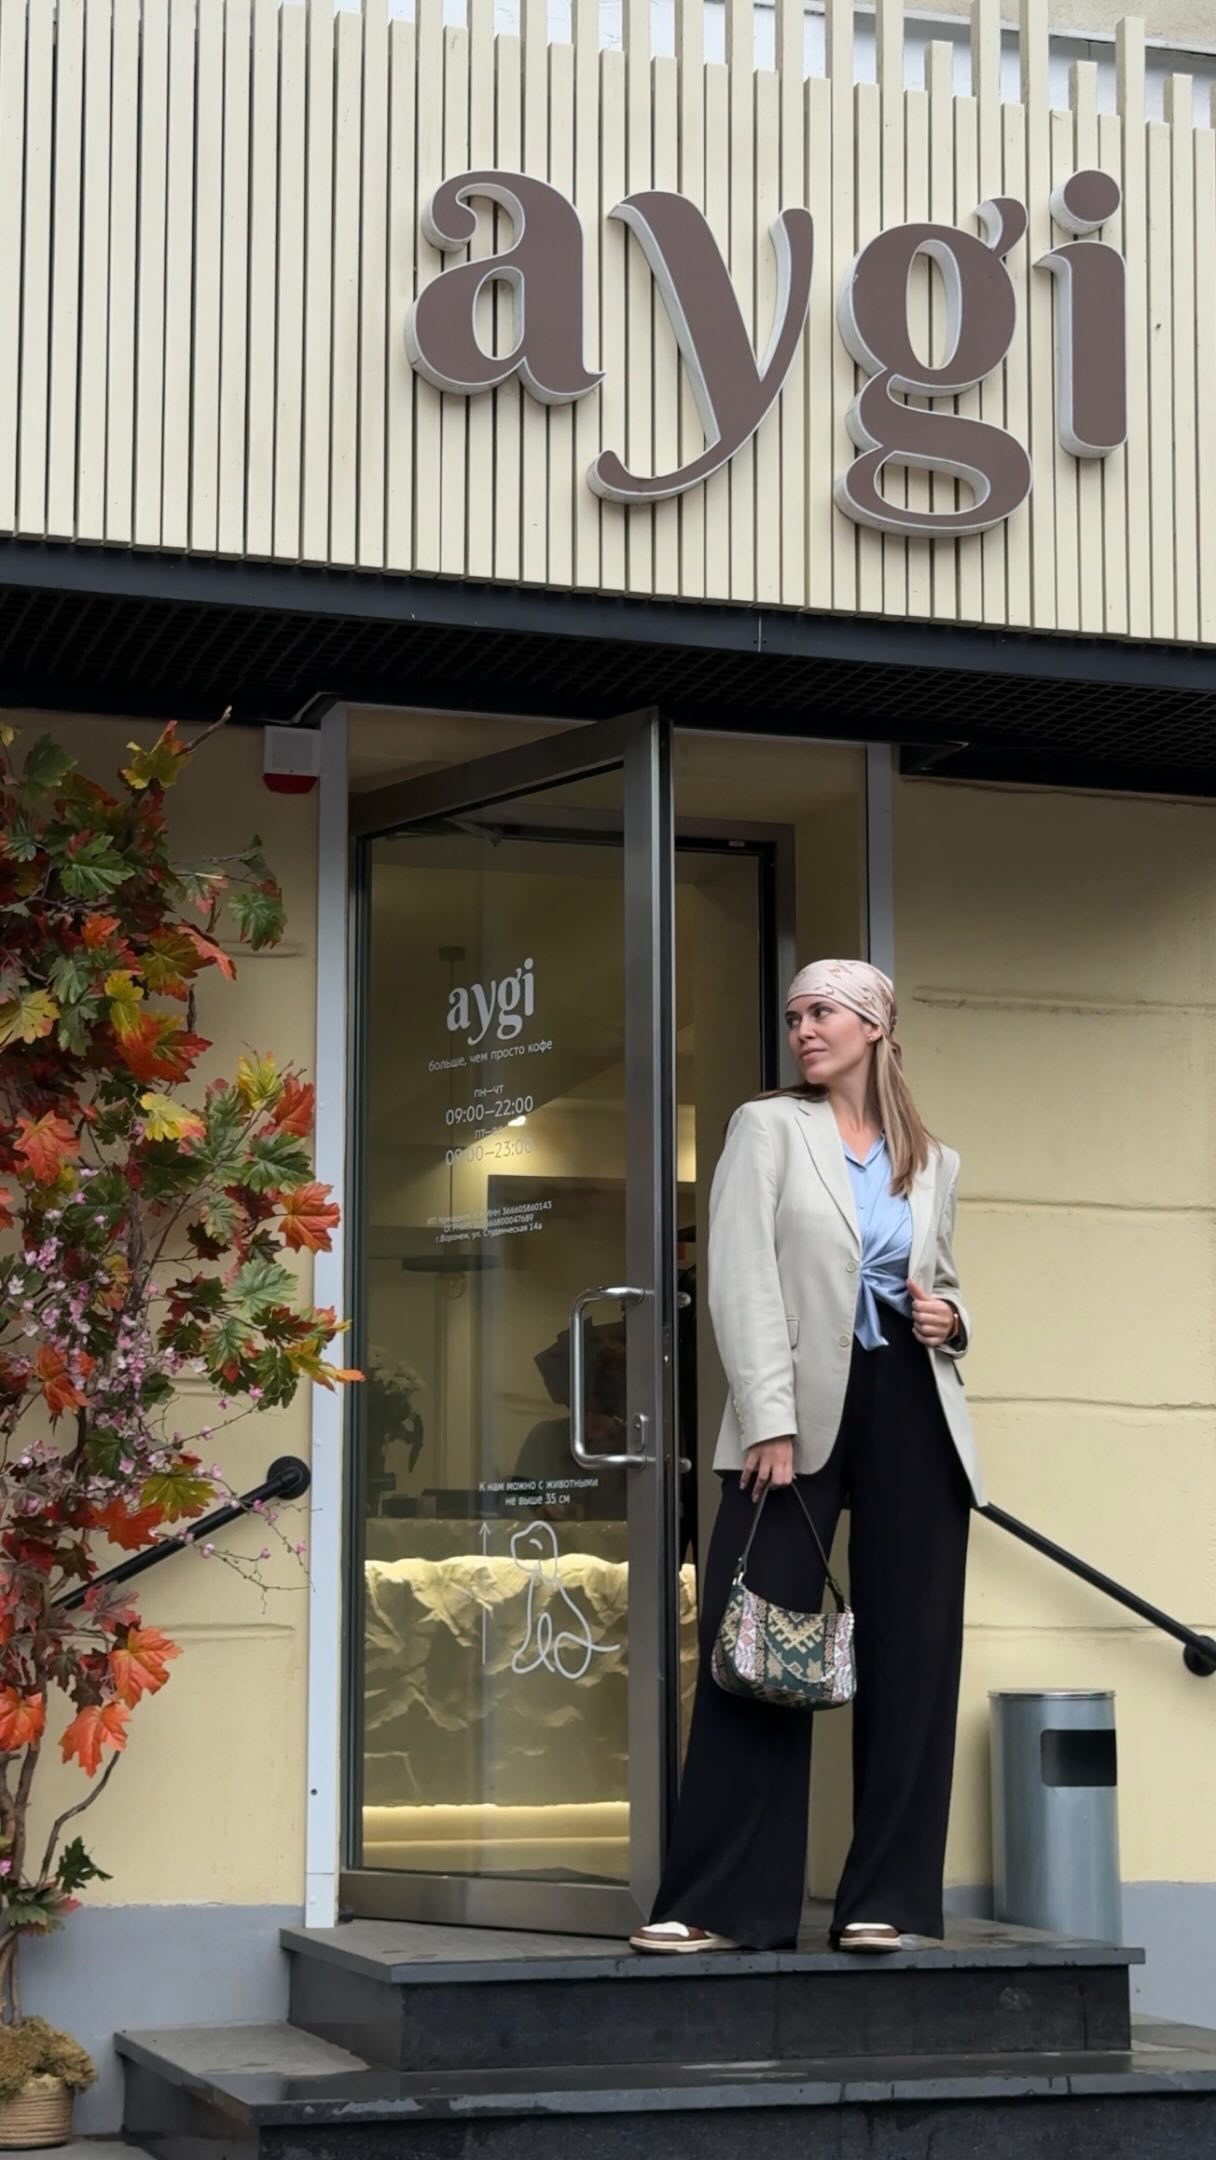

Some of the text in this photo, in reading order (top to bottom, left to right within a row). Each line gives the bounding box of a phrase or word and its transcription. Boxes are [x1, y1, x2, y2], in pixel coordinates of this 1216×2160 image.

[405, 168, 1128, 538] aygi
[446, 957, 535, 1046] aygi
[429, 1039, 553, 1072] больше, чем просто кофе
[479, 1481, 486, 1492] К
[487, 1481, 505, 1492] нам
[506, 1480, 536, 1491] можно
[545, 1478, 599, 1489] животными
[505, 1492, 570, 1506] не выше 35 см
